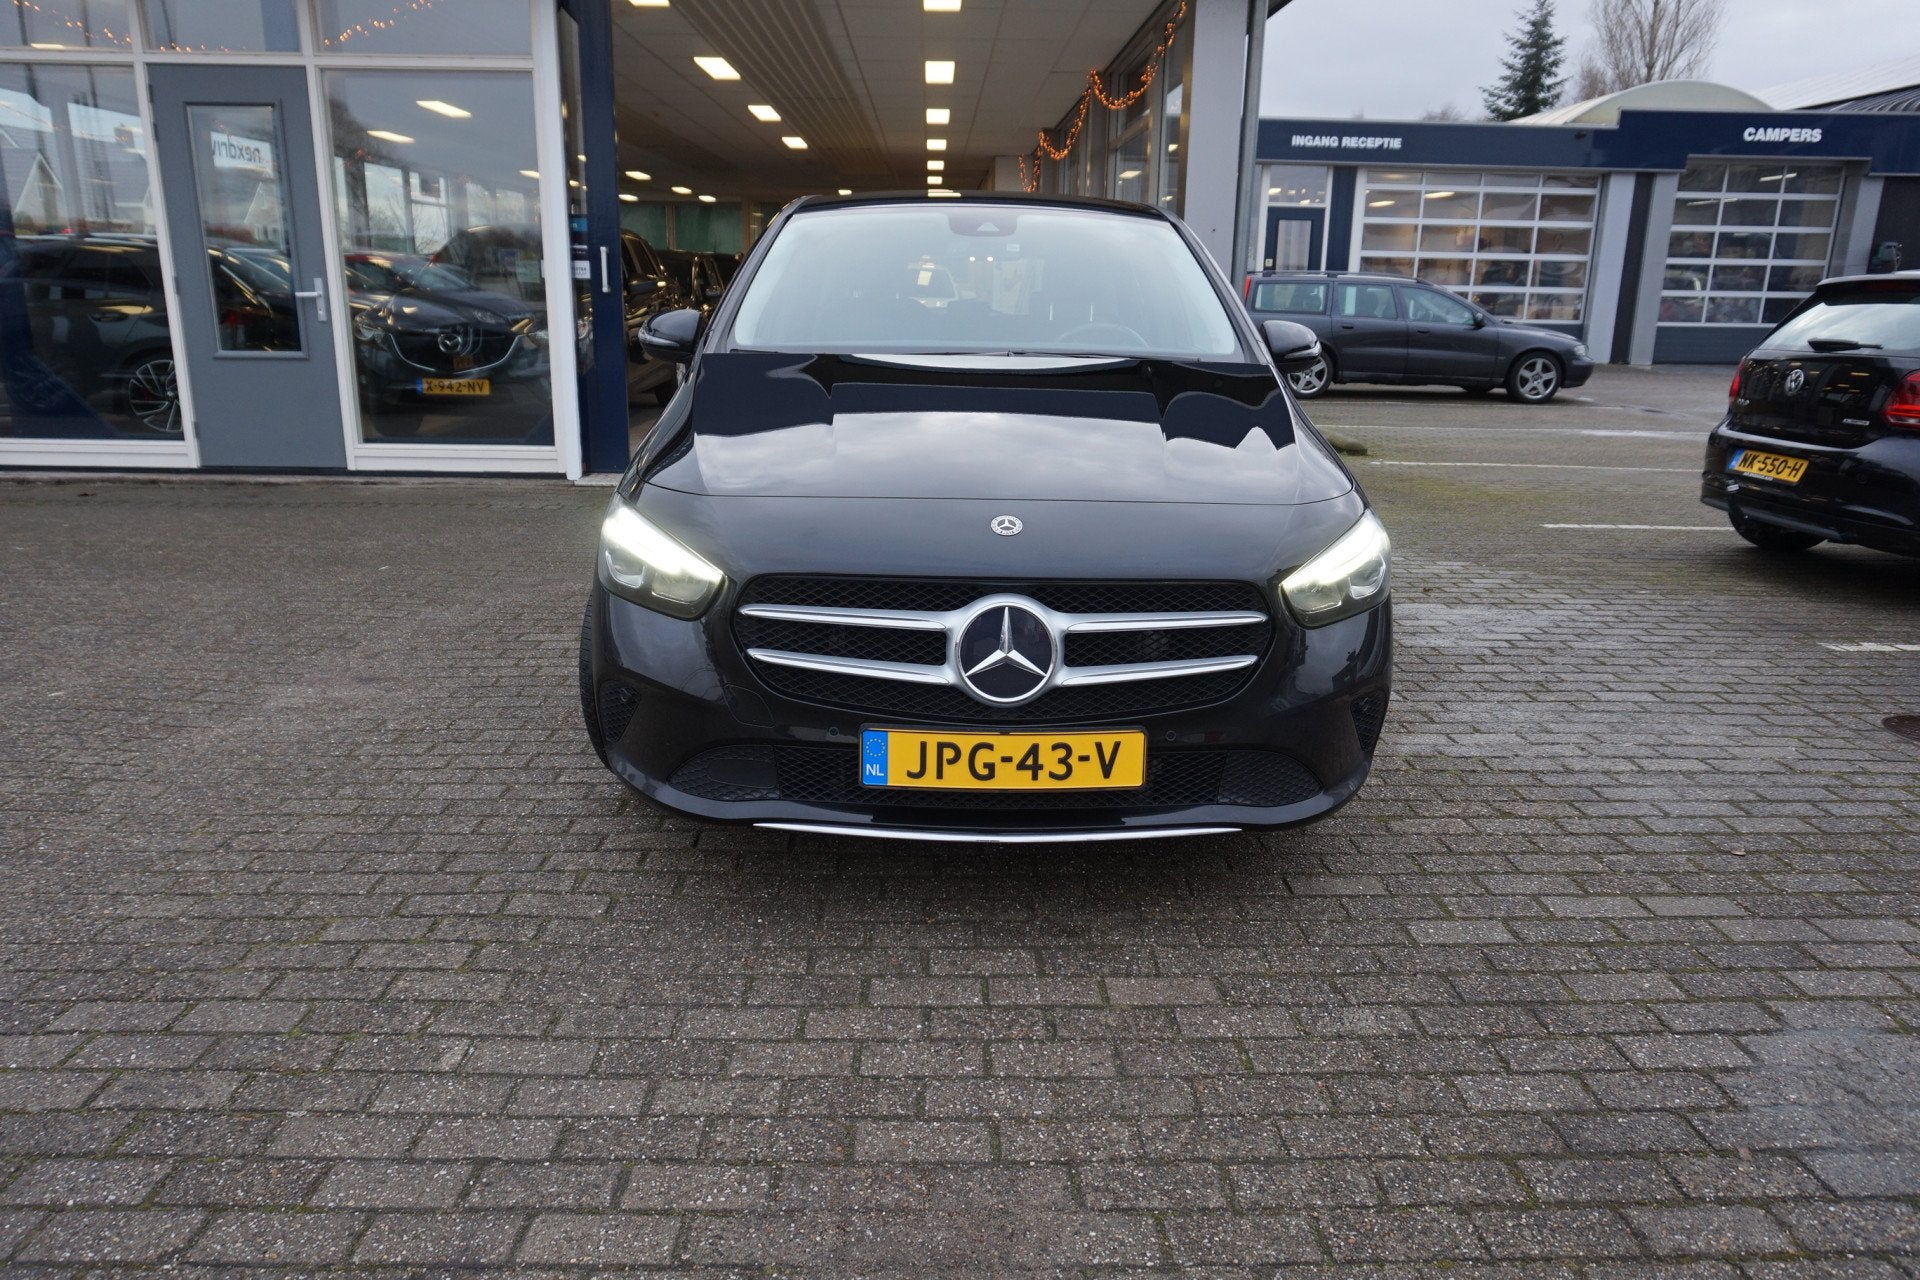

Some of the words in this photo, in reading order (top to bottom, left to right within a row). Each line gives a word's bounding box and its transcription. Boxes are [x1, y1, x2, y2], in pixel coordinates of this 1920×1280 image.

[1743, 127, 1822, 142] CAMPERS
[1292, 135, 1339, 148] INGANG
[1341, 136, 1402, 149] RECEPTIE
[426, 380, 485, 393] X-942-NV
[1738, 453, 1805, 478] NK-550-H
[906, 740, 1121, 781] JPG-43-V
[865, 763, 884, 776] NL
